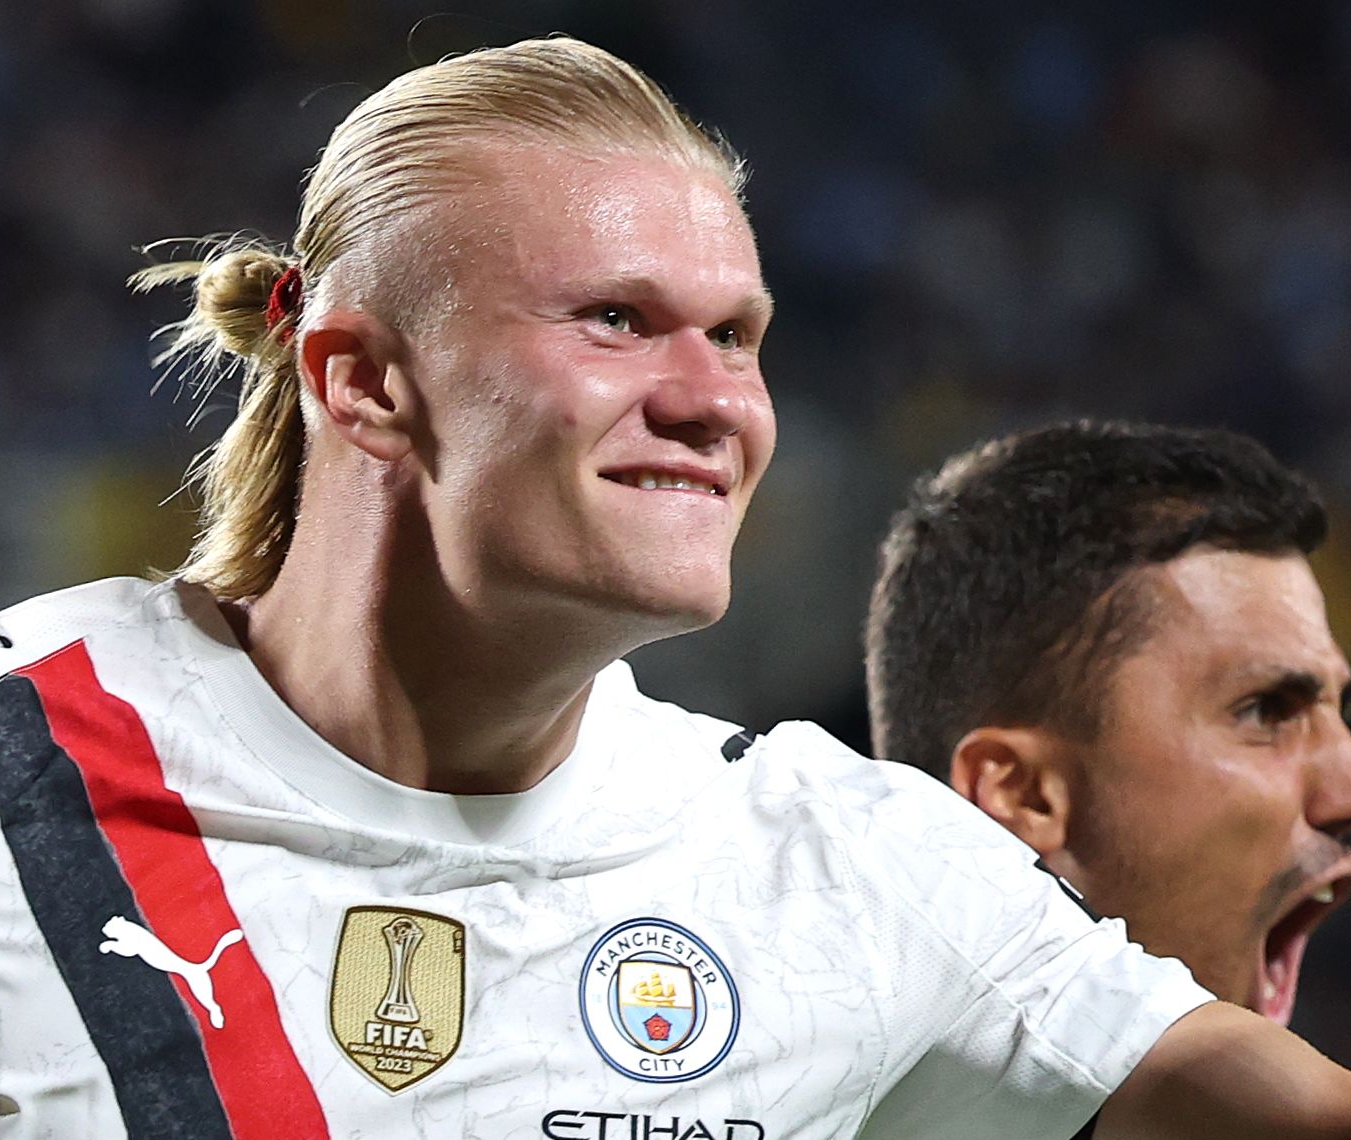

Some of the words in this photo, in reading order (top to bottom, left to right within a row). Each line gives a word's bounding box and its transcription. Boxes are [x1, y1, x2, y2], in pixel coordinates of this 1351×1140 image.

[595, 932, 717, 985] MANCHESTER
[366, 1022, 427, 1050] FIFA
[349, 1043, 384, 1055] WORLD
[386, 1048, 442, 1063] CHAMPIONS
[377, 1057, 412, 1073] 2023
[639, 1058, 685, 1071] CITY
